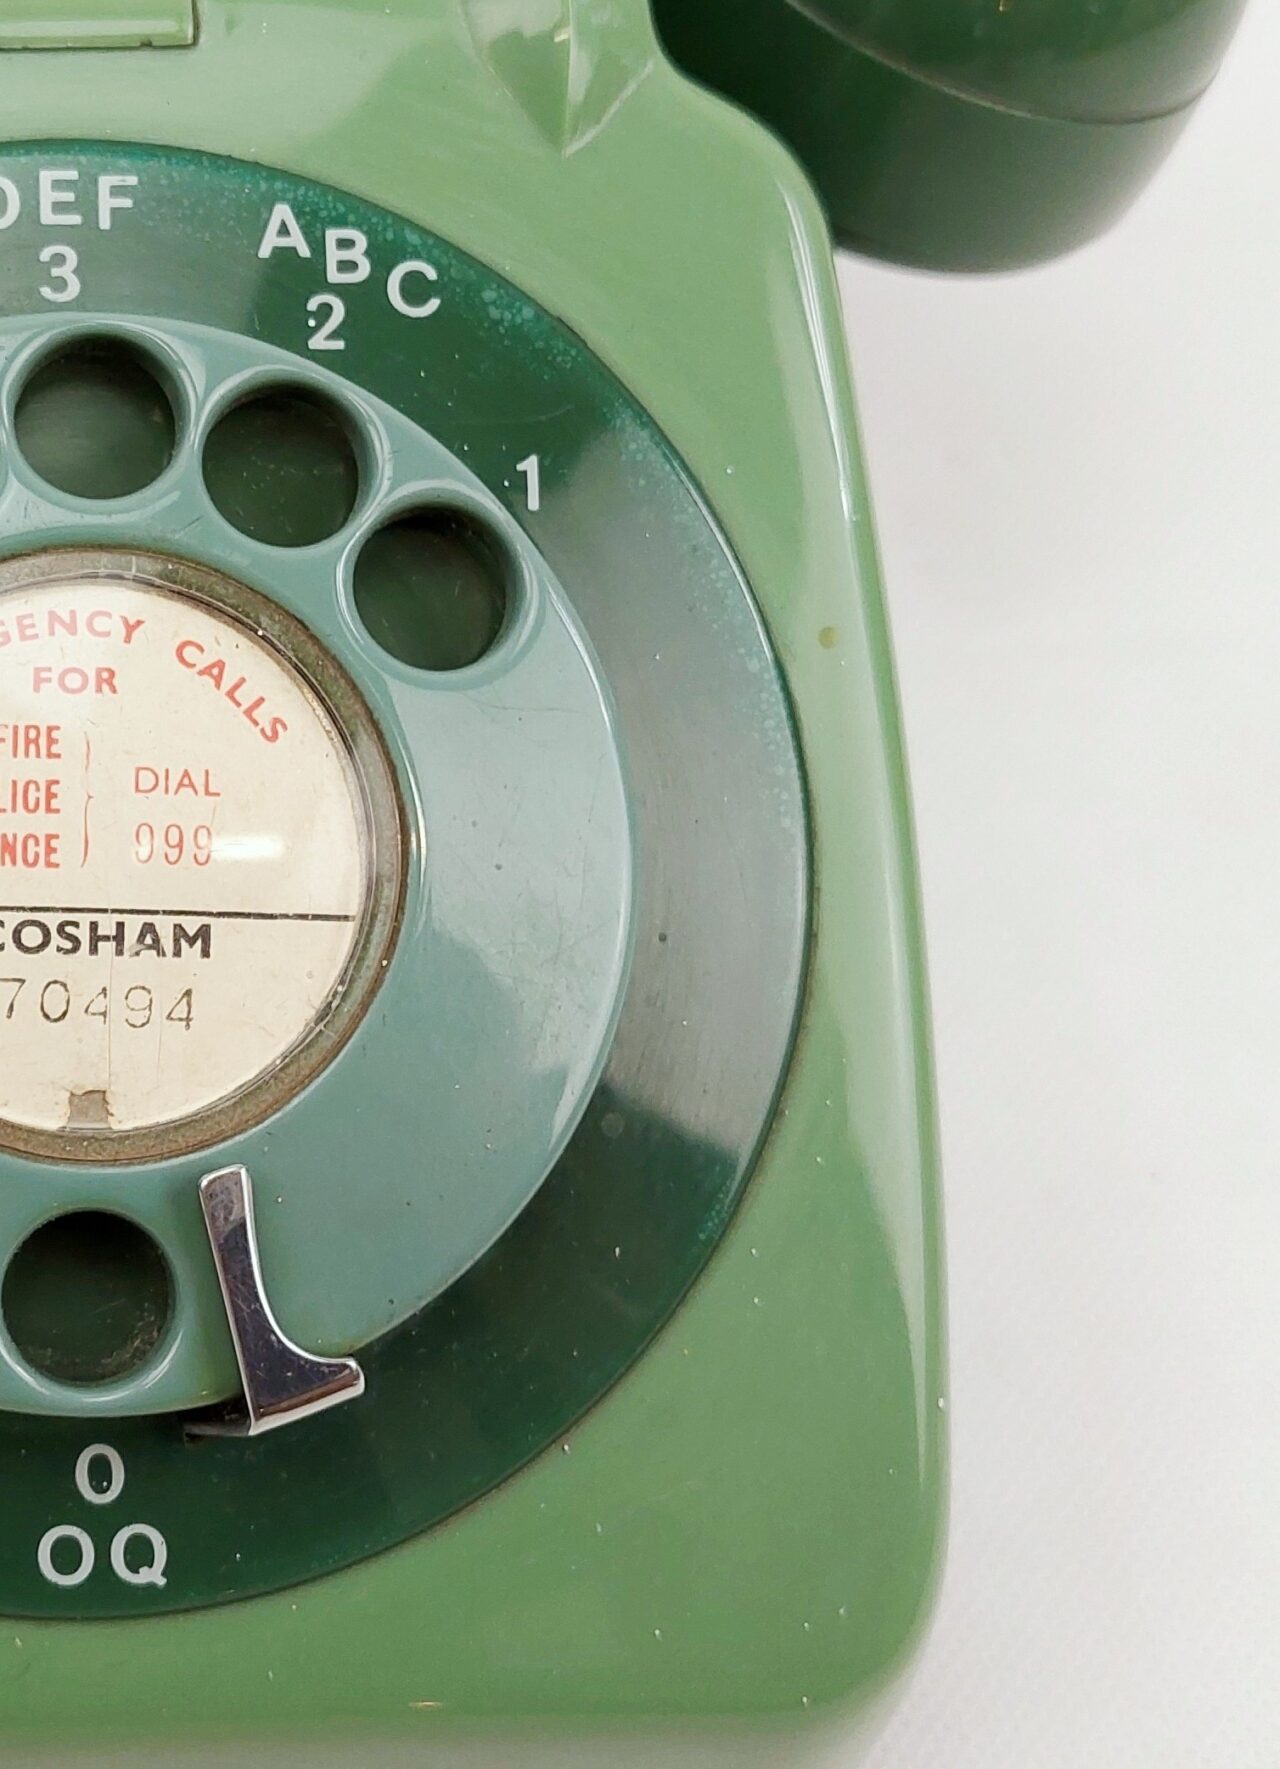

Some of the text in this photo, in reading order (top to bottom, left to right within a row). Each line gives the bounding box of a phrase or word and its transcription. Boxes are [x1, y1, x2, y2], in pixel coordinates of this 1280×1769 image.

[38, 245, 82, 303] 3
[256, 203, 441, 318] ABC
[306, 294, 347, 350] 2
[516, 455, 541, 511] 1
[32, 666, 119, 695] FOR
[175, 638, 290, 746] CALLS
[132, 767, 221, 798] DIAL
[133, 822, 216, 867] 999
